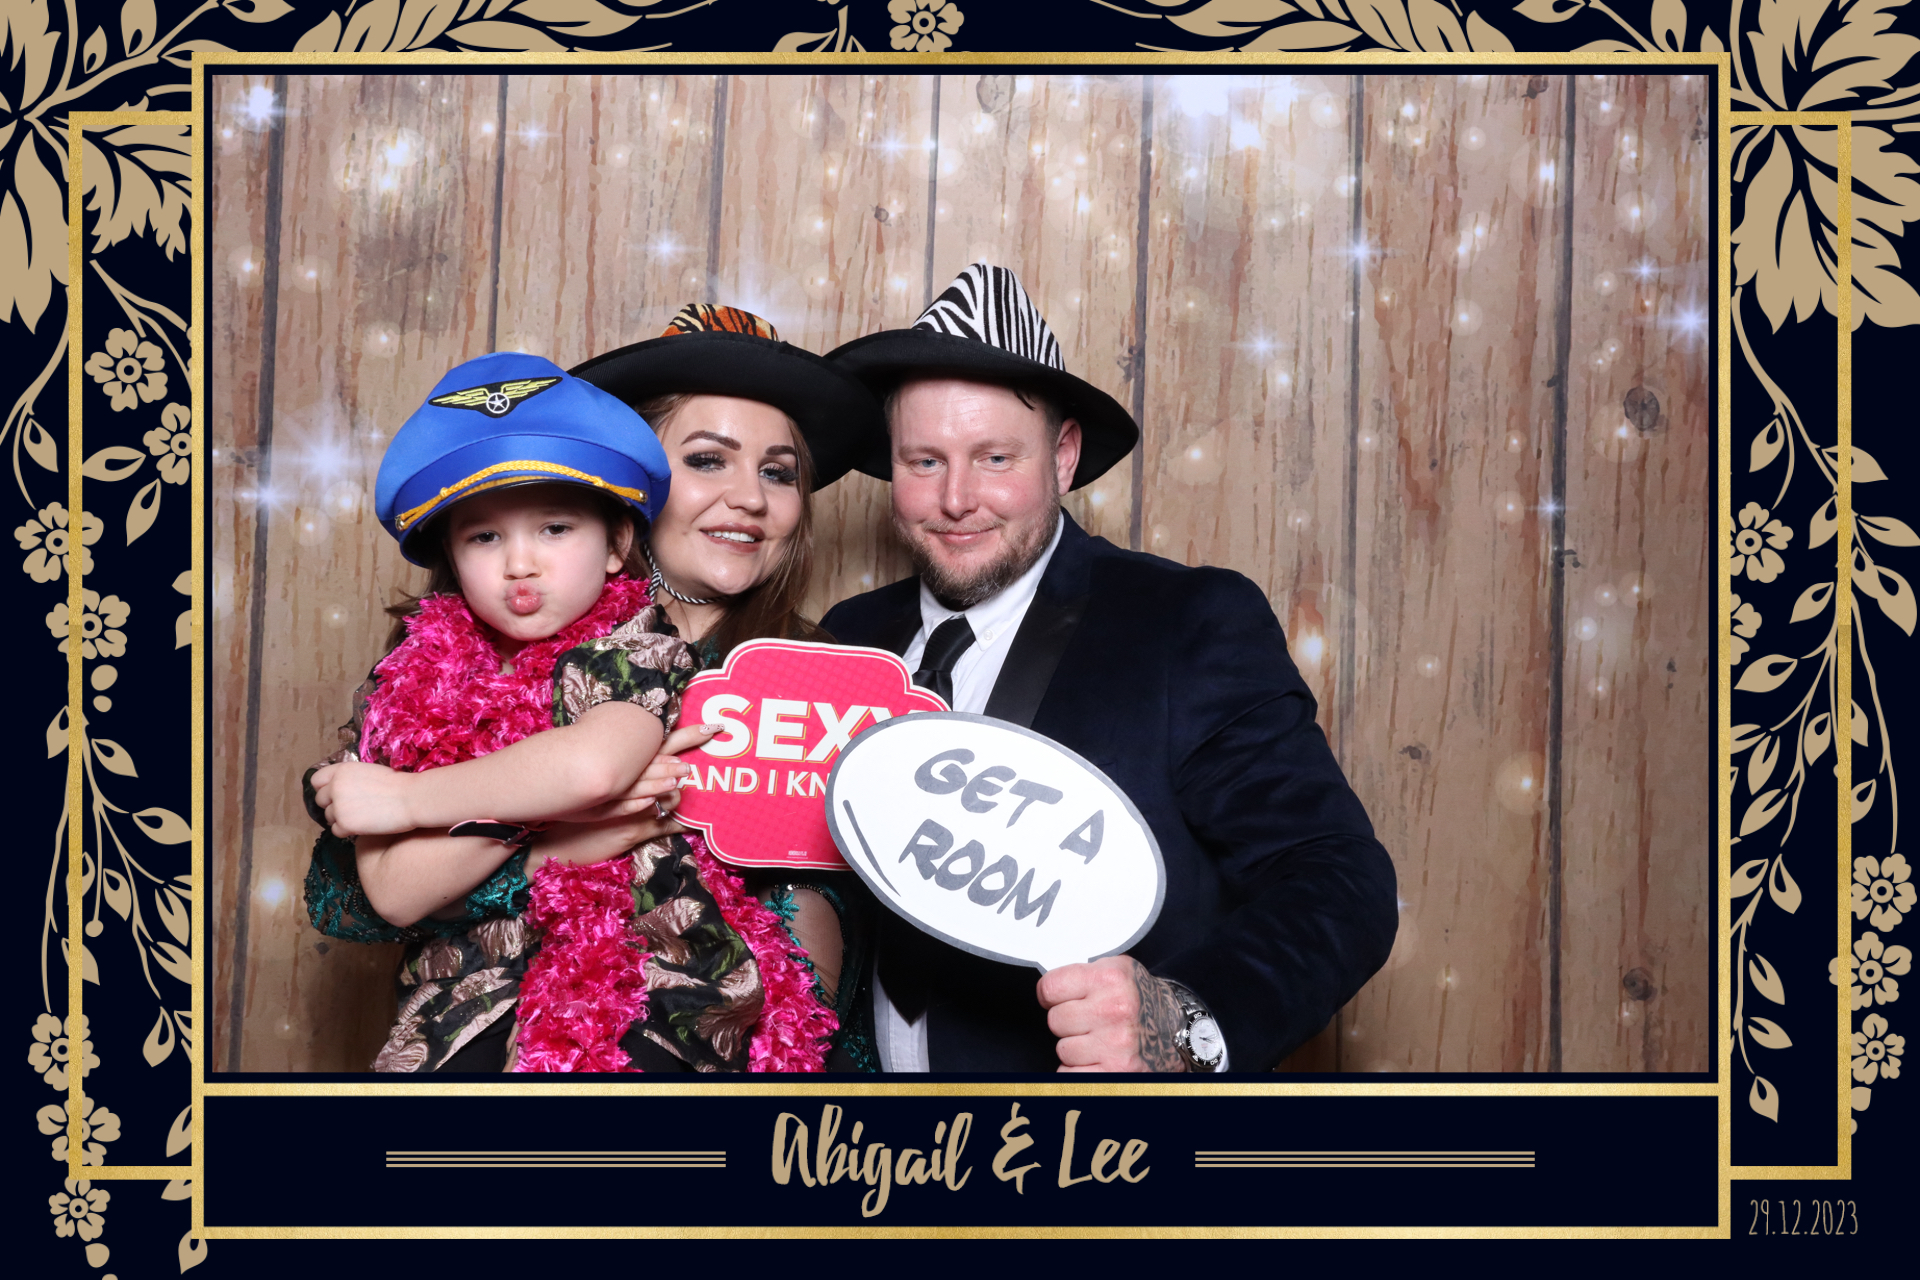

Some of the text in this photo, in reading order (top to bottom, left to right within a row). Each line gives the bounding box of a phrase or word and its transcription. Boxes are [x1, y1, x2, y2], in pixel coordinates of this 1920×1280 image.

[699, 693, 930, 764] SEX
[676, 763, 760, 794] AND
[767, 769, 779, 796] I
[914, 748, 1105, 865] GET A
[898, 818, 1061, 927] ROOM
